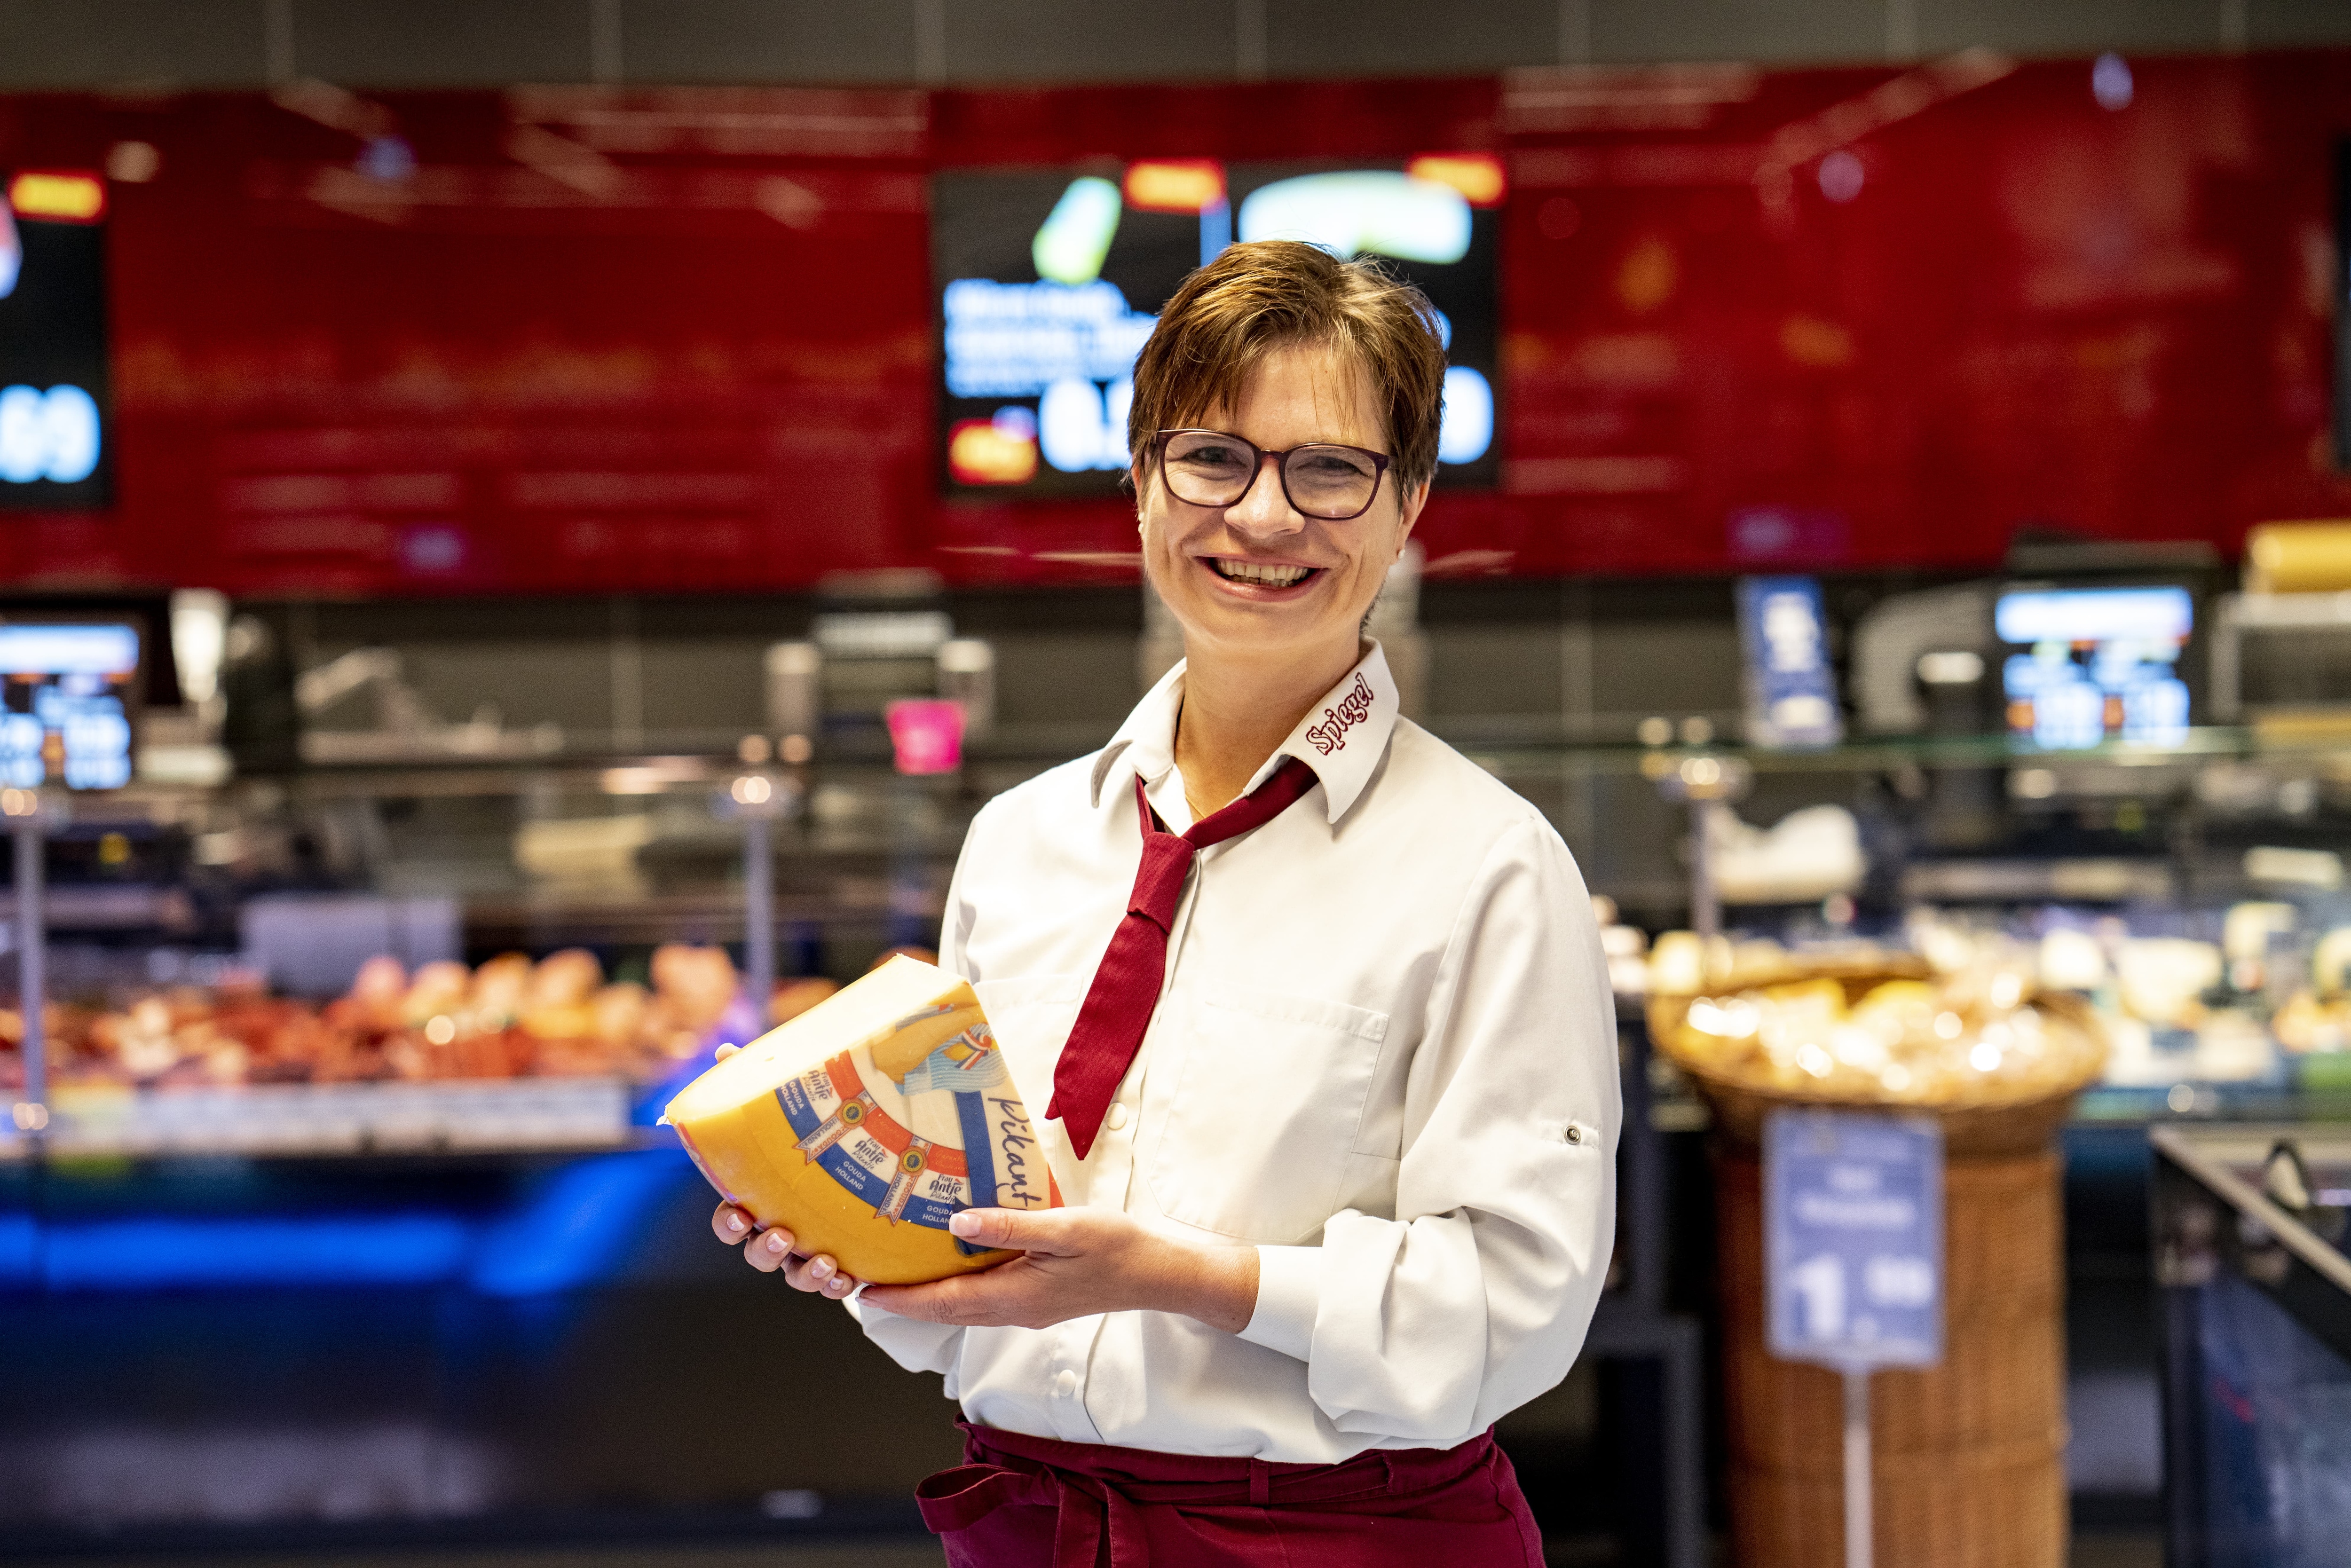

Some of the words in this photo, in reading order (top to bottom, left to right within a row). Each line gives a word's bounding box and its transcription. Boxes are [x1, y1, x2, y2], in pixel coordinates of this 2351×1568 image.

[1305, 671, 1373, 756] Spiegel
[808, 1070, 829, 1100] Antje
[820, 1072, 831, 1087] Frau
[789, 1081, 804, 1109] GOUDA
[818, 1129, 842, 1150] GOUDA
[867, 1137, 881, 1150] Frau
[855, 1140, 884, 1165] Antje
[835, 1166, 863, 1190] HOLLAND
[843, 1161, 867, 1182] GOUDA
[938, 1174, 953, 1182] Frau
[884, 1176, 903, 1208] HOLLAND
[896, 1182, 911, 1207] GOUDA
[929, 1180, 962, 1195] Antje
[922, 1213, 950, 1224] HOLLAN
[927, 1205, 953, 1215] GOUDA
